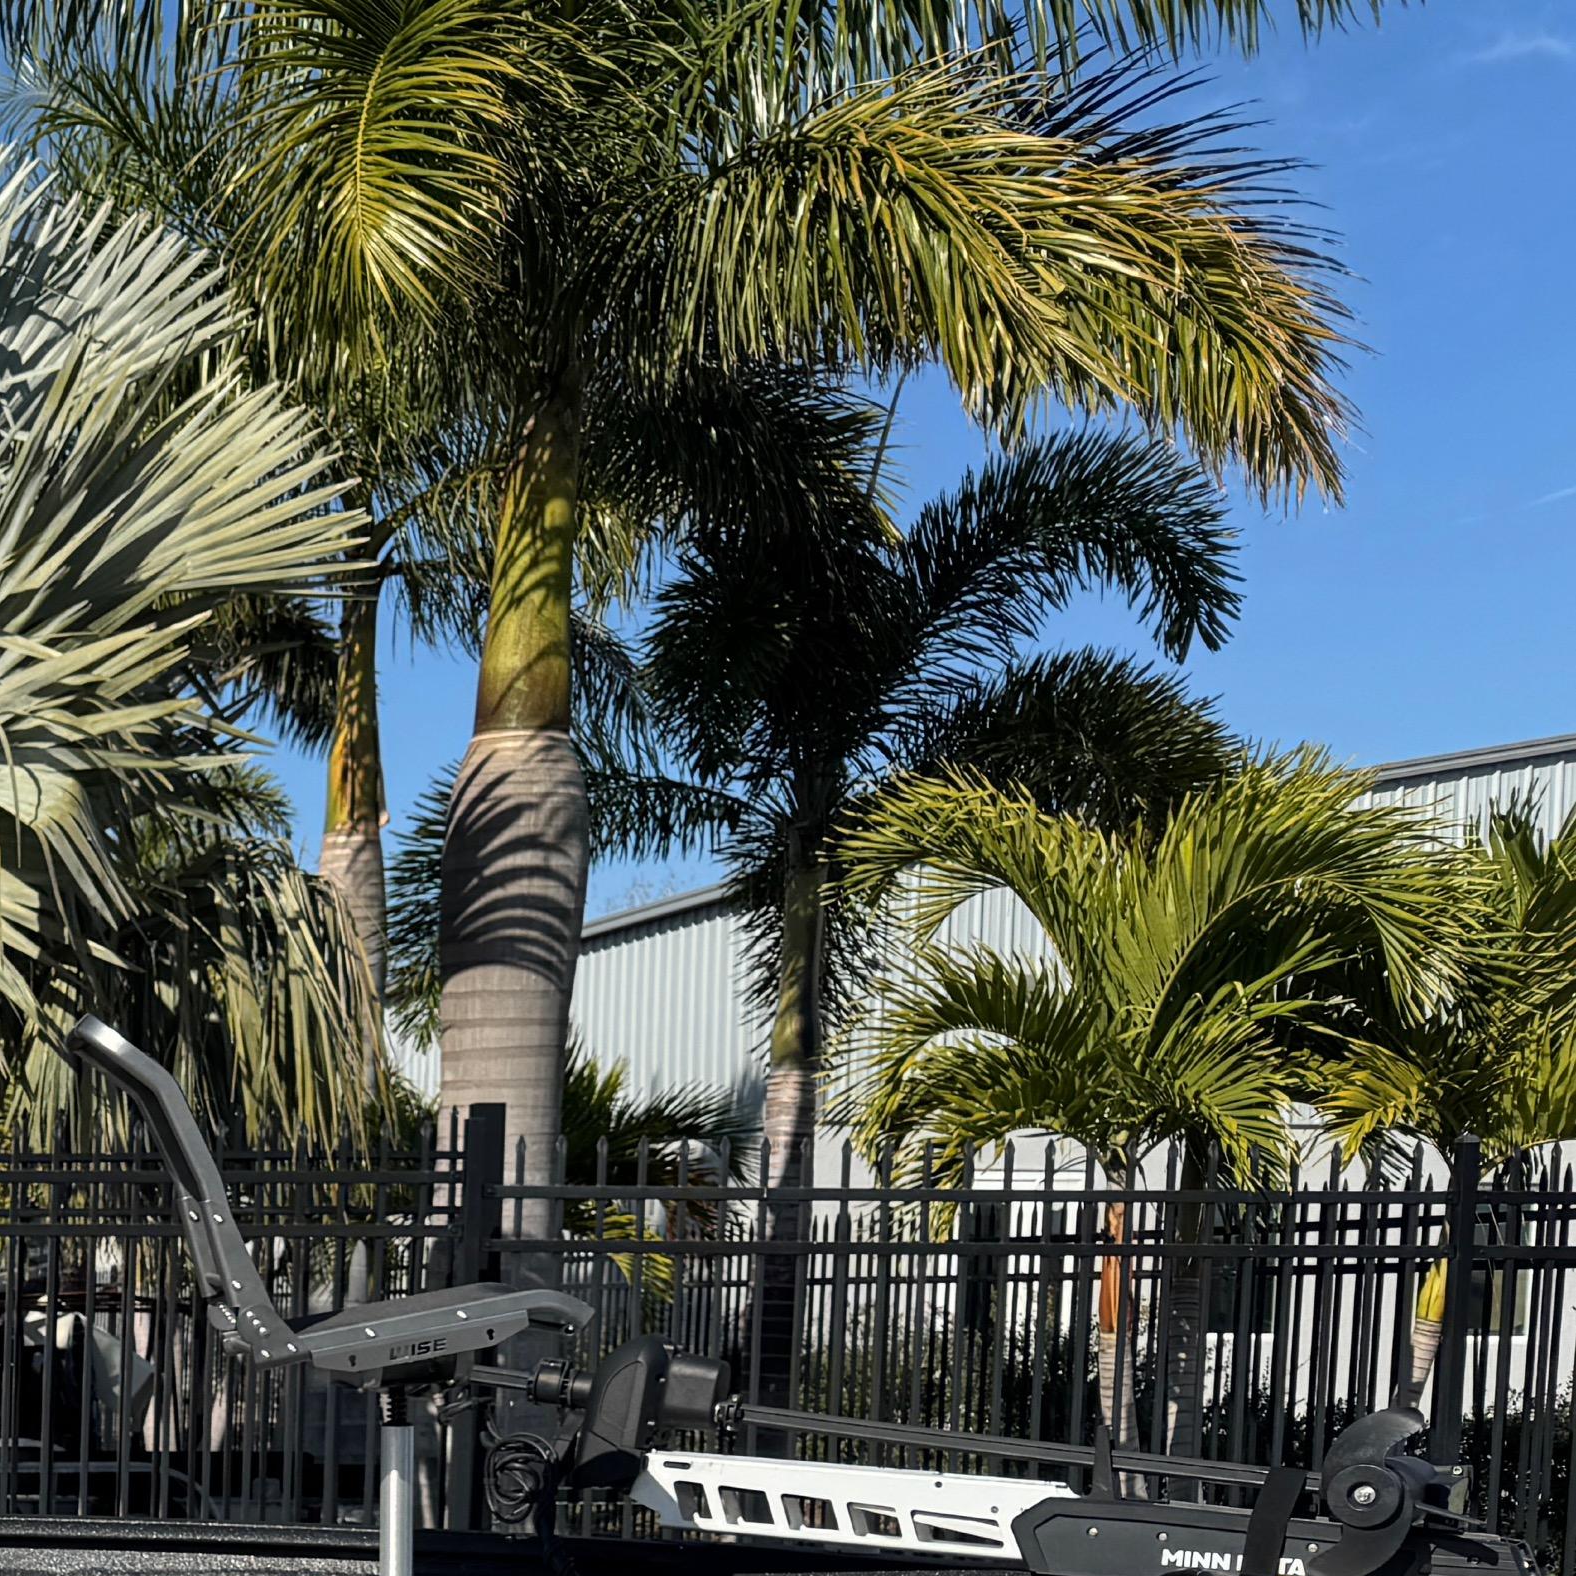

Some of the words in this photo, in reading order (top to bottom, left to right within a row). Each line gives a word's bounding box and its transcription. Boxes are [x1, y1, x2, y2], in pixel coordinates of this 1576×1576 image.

[389, 1338, 447, 1361] WISE
[1161, 1548, 1232, 1572] MINN
[1236, 1554, 1306, 1576] TA
